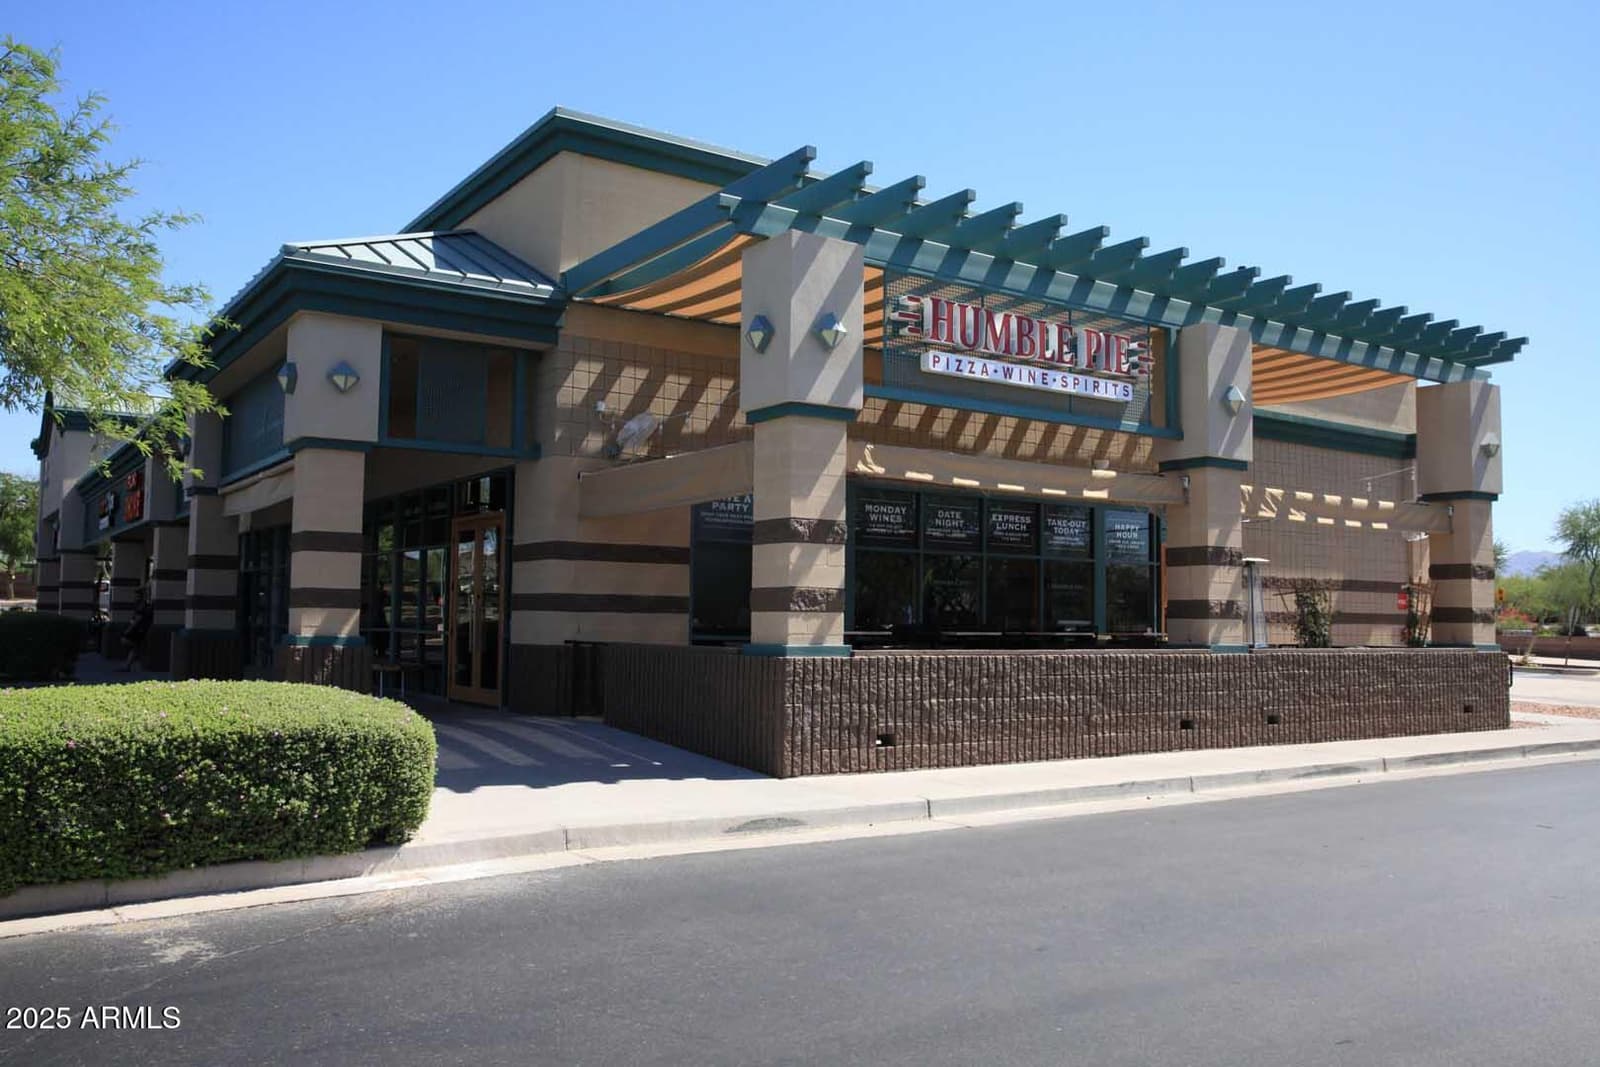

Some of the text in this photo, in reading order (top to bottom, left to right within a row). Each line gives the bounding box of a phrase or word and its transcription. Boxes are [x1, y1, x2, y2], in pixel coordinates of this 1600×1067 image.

[926, 296, 1131, 376] HUMBLE PIE
[931, 354, 1131, 398] PIZZA WINE SPIRITS
[712, 501, 750, 513] PARTY
[865, 504, 907, 515] MONDAY
[869, 513, 903, 522] WINES
[937, 510, 961, 519] DATE
[992, 513, 1031, 524] EXPRESS
[935, 518, 964, 528] NIGHT
[996, 522, 1027, 531] LUNCH
[1047, 518, 1086, 529] TAKE-OUT
[1115, 524, 1140, 532] HAPPY
[1054, 527, 1079, 537] TODAY
[1116, 531, 1138, 539] HOUR
